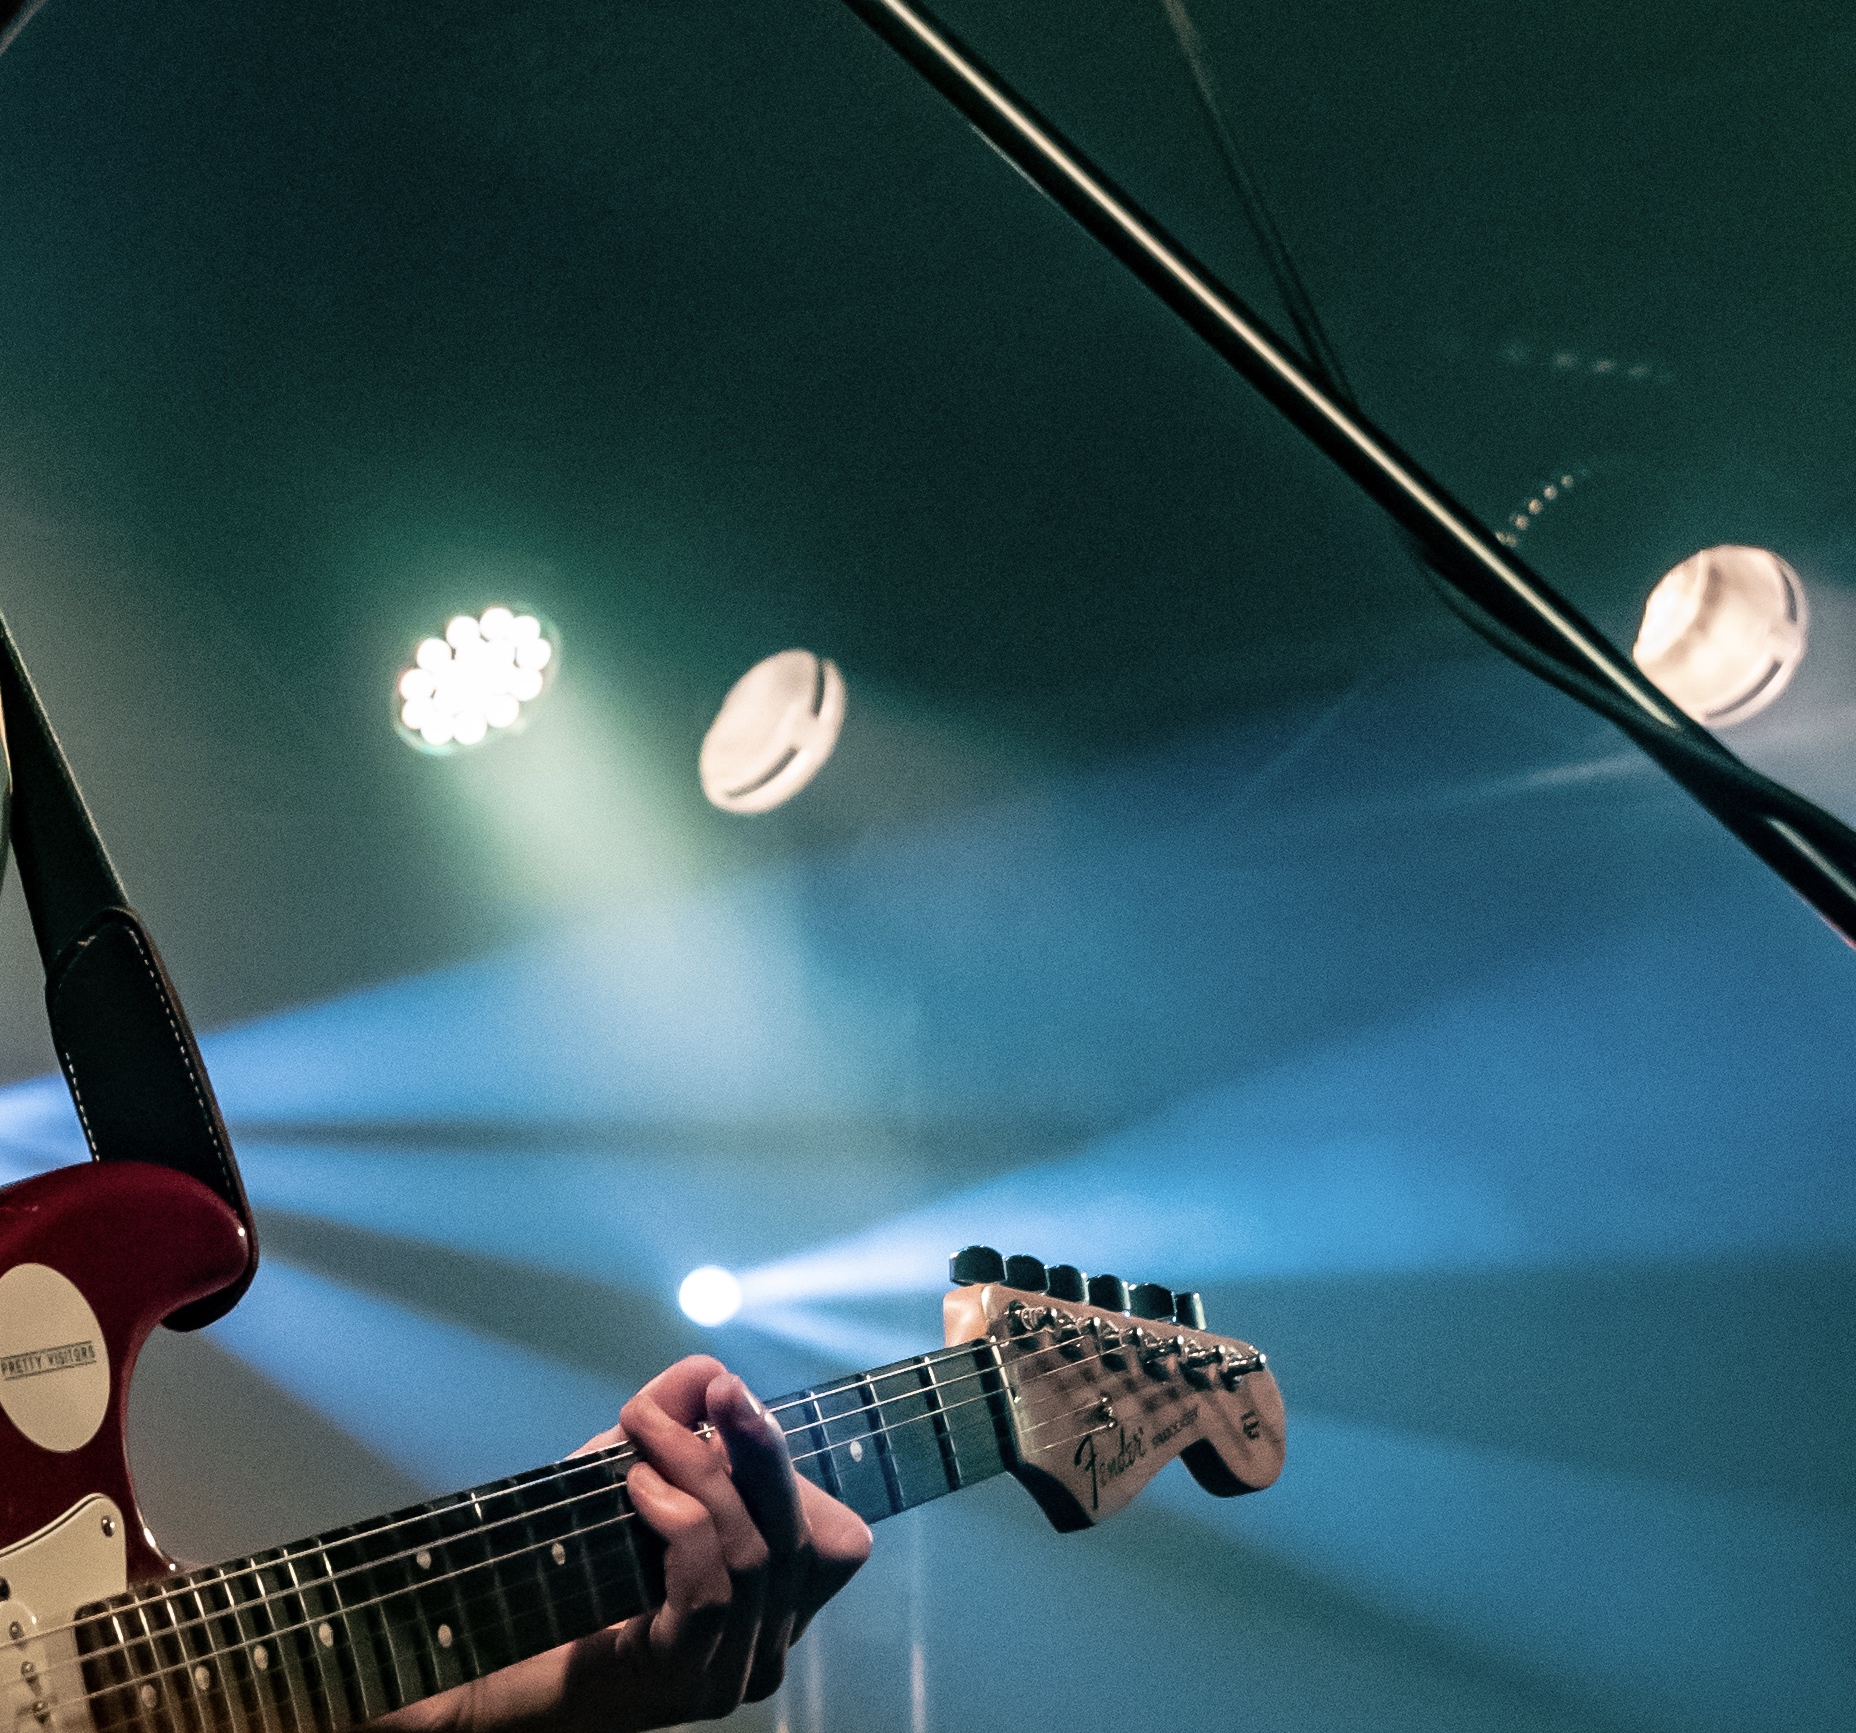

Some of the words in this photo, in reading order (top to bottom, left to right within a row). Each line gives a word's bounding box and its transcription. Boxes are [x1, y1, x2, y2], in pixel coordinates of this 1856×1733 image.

[0, 1355, 43, 1376] PRETTY
[47, 1344, 96, 1367] VISITORS
[1073, 1426, 1147, 1510] Fender
